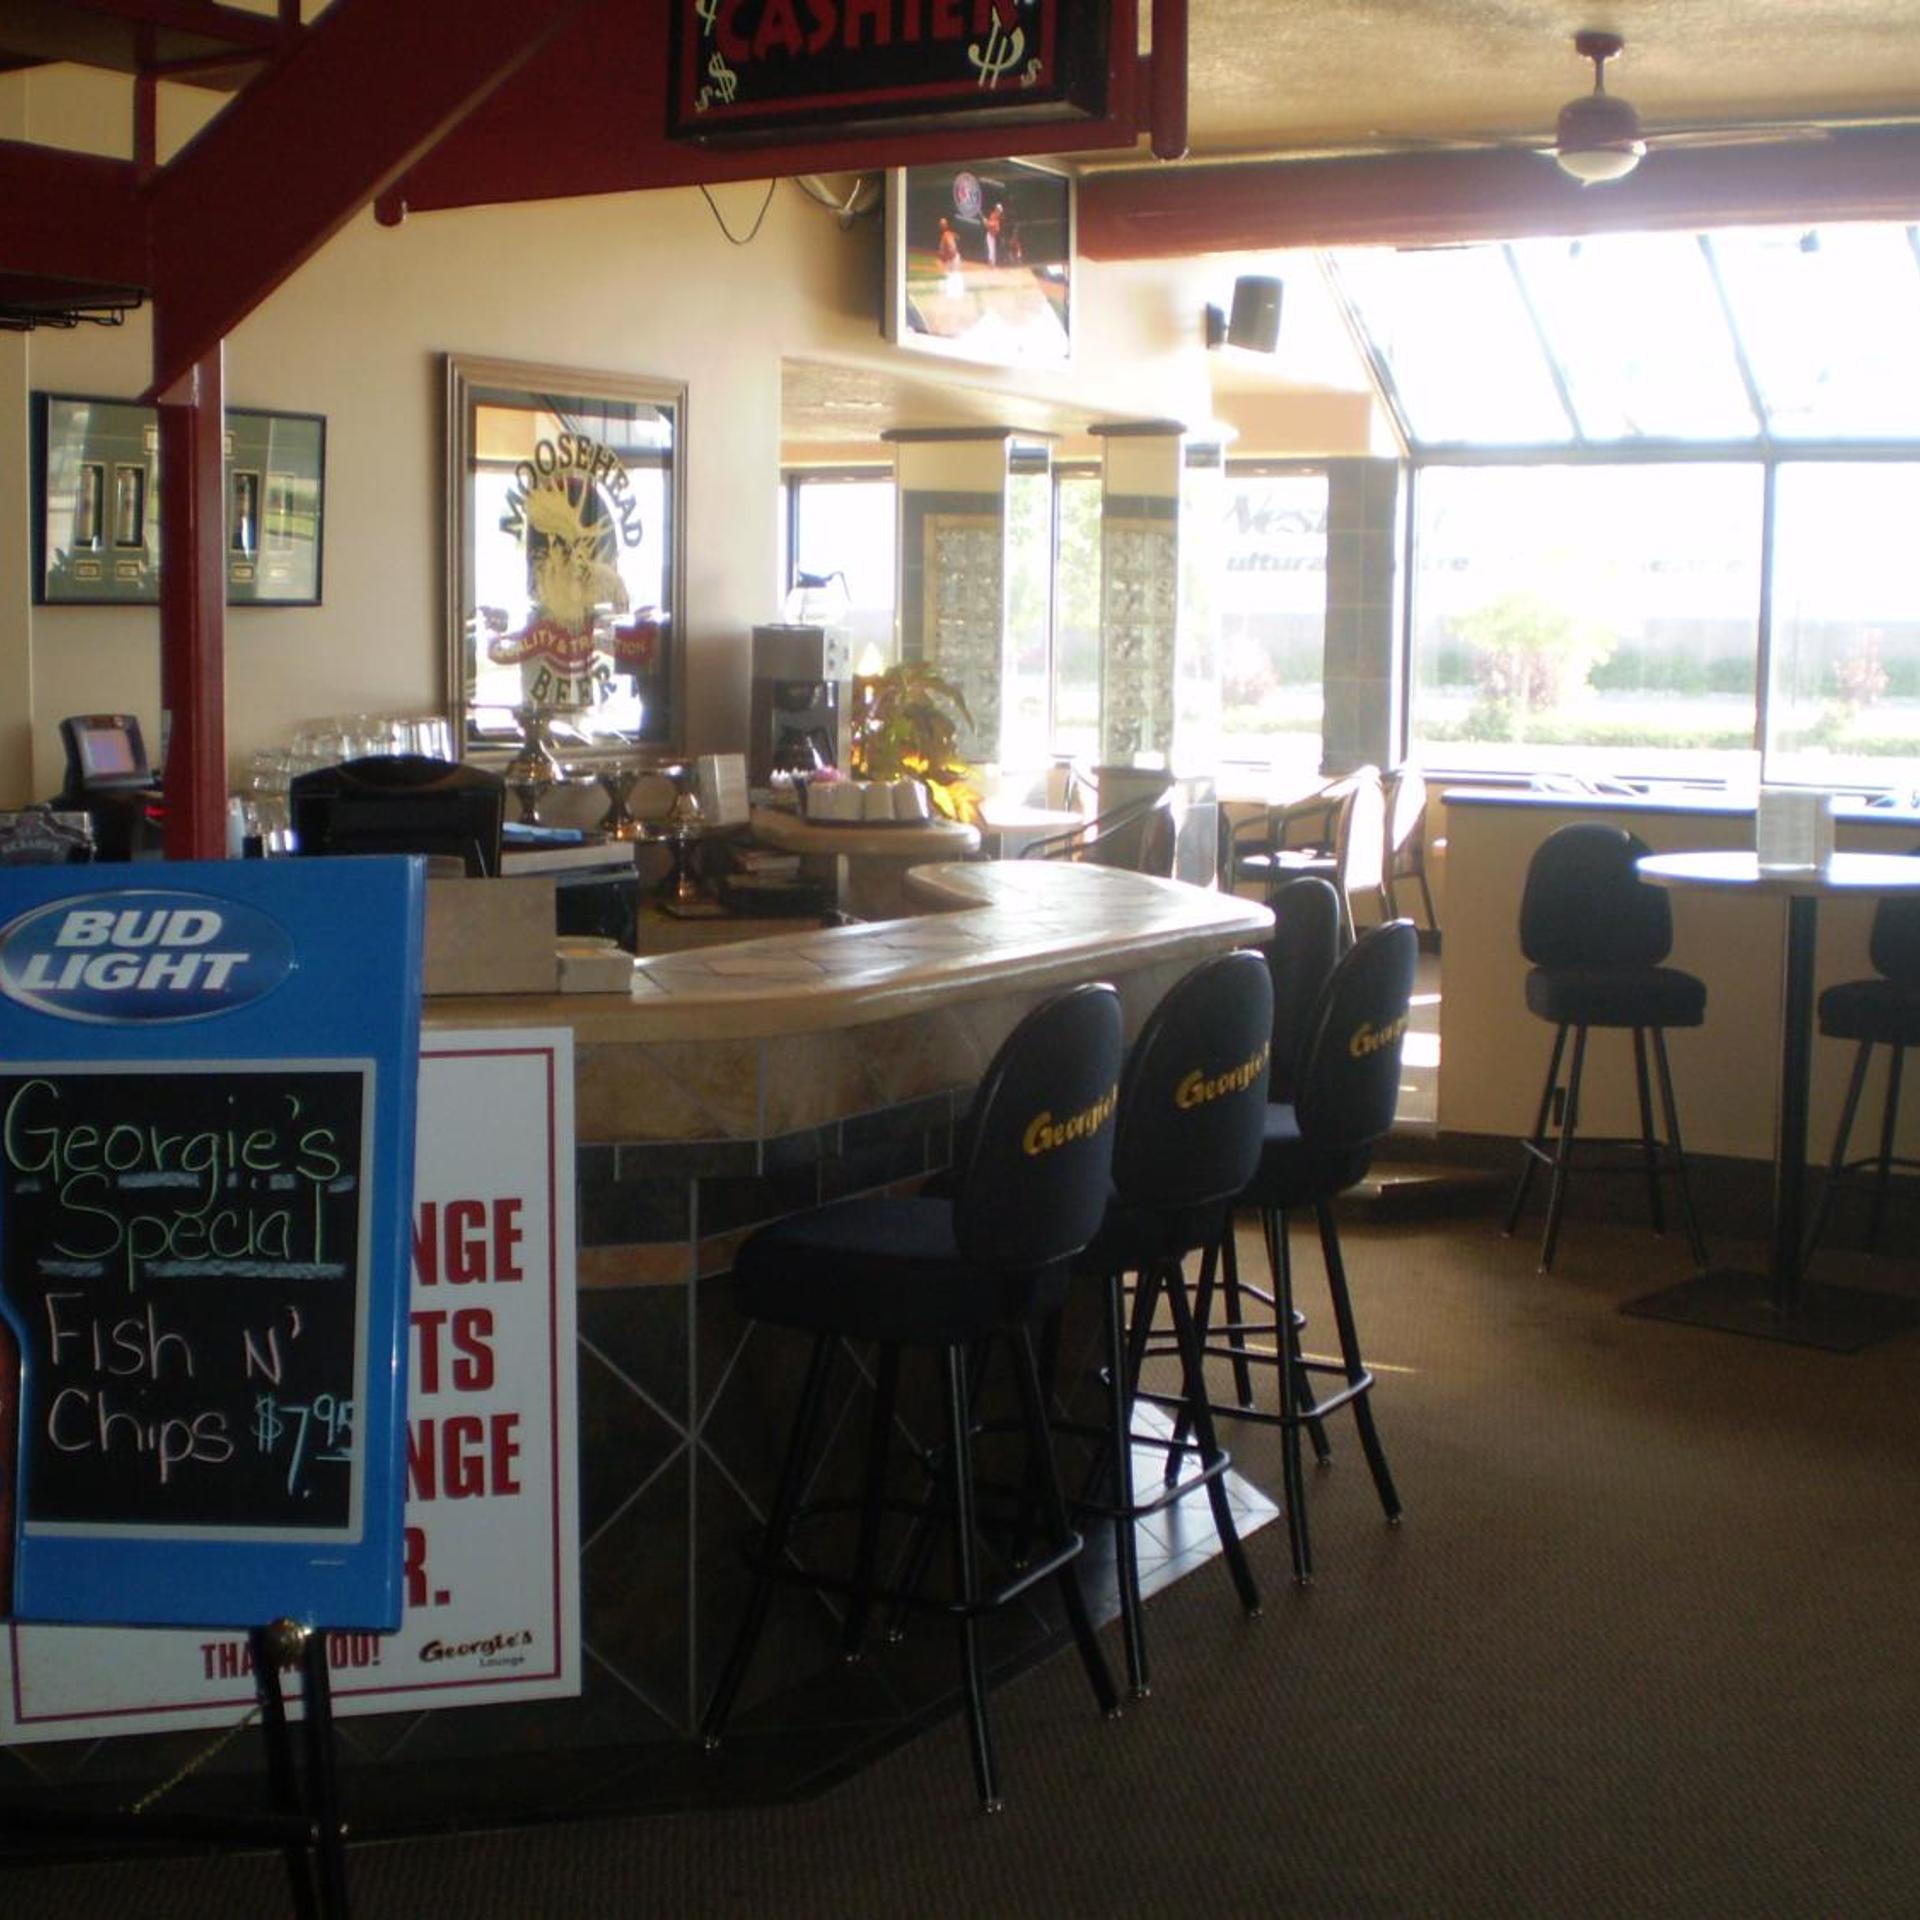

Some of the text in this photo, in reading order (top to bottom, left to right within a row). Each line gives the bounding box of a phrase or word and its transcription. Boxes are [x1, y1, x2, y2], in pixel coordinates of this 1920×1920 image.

[500, 432, 643, 548] MOOSEHEAD
[20, 952, 250, 990] LIGHT
[54, 909, 223, 947] BUD
[4, 1078, 341, 1216] Georgie's
[53, 1171, 322, 1292] Special
[45, 1292, 194, 1380] Fish
[47, 1387, 235, 1484] Chips
[418, 1629, 534, 1663] Georgie's
